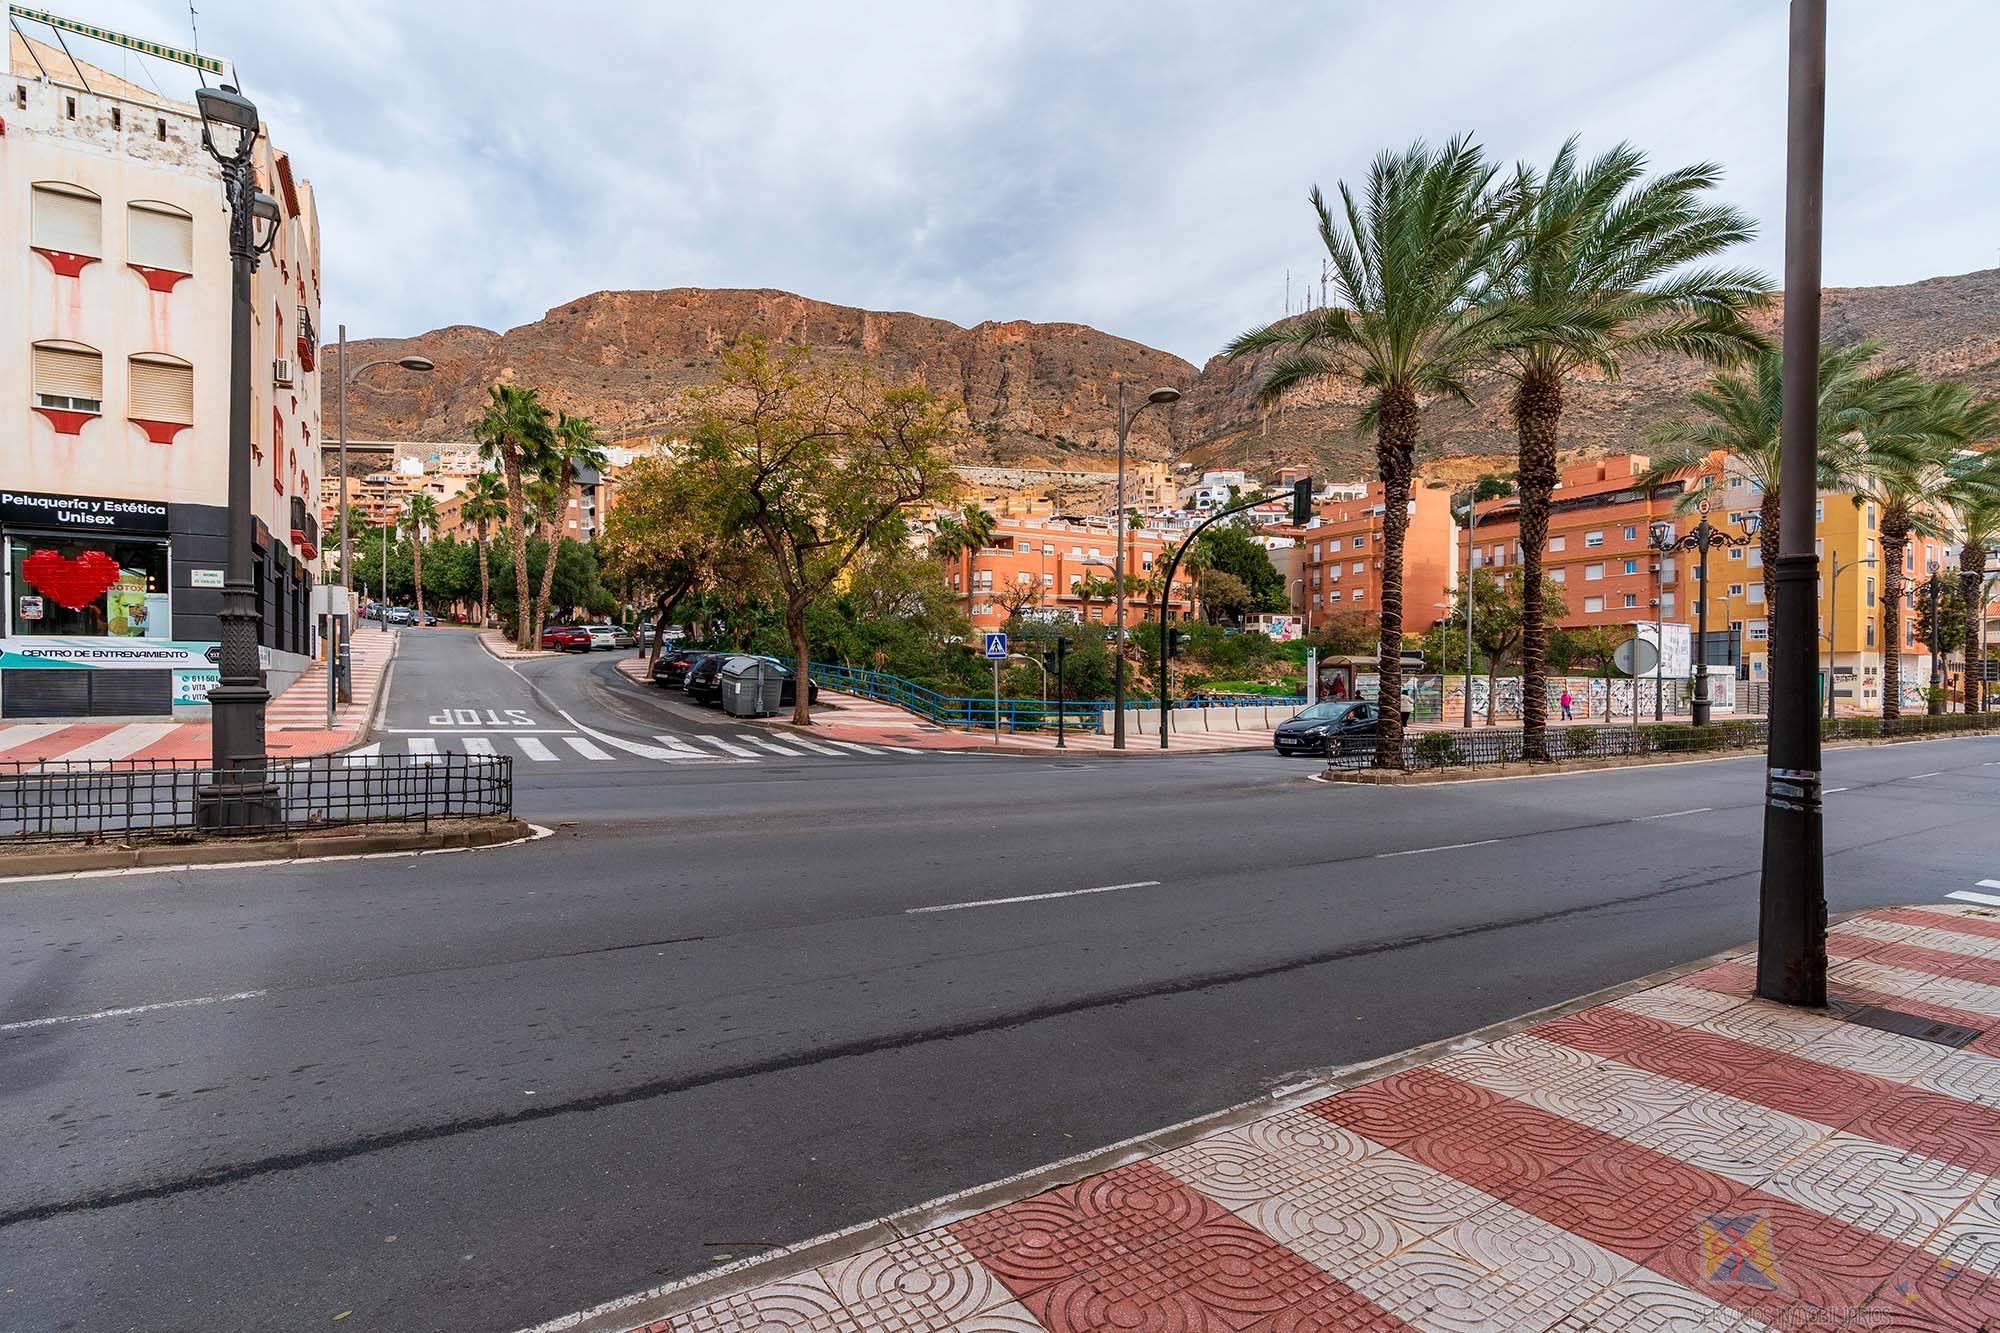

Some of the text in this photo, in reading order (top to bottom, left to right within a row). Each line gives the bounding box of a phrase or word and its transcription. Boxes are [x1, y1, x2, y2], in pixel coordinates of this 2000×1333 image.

[1, 493, 166, 515] Peluquería y Estética
[57, 510, 115, 525] Unisex
[21, 649, 189, 659] CENTRO DE ENTRENAMIENTO
[428, 708, 537, 725] STOP
